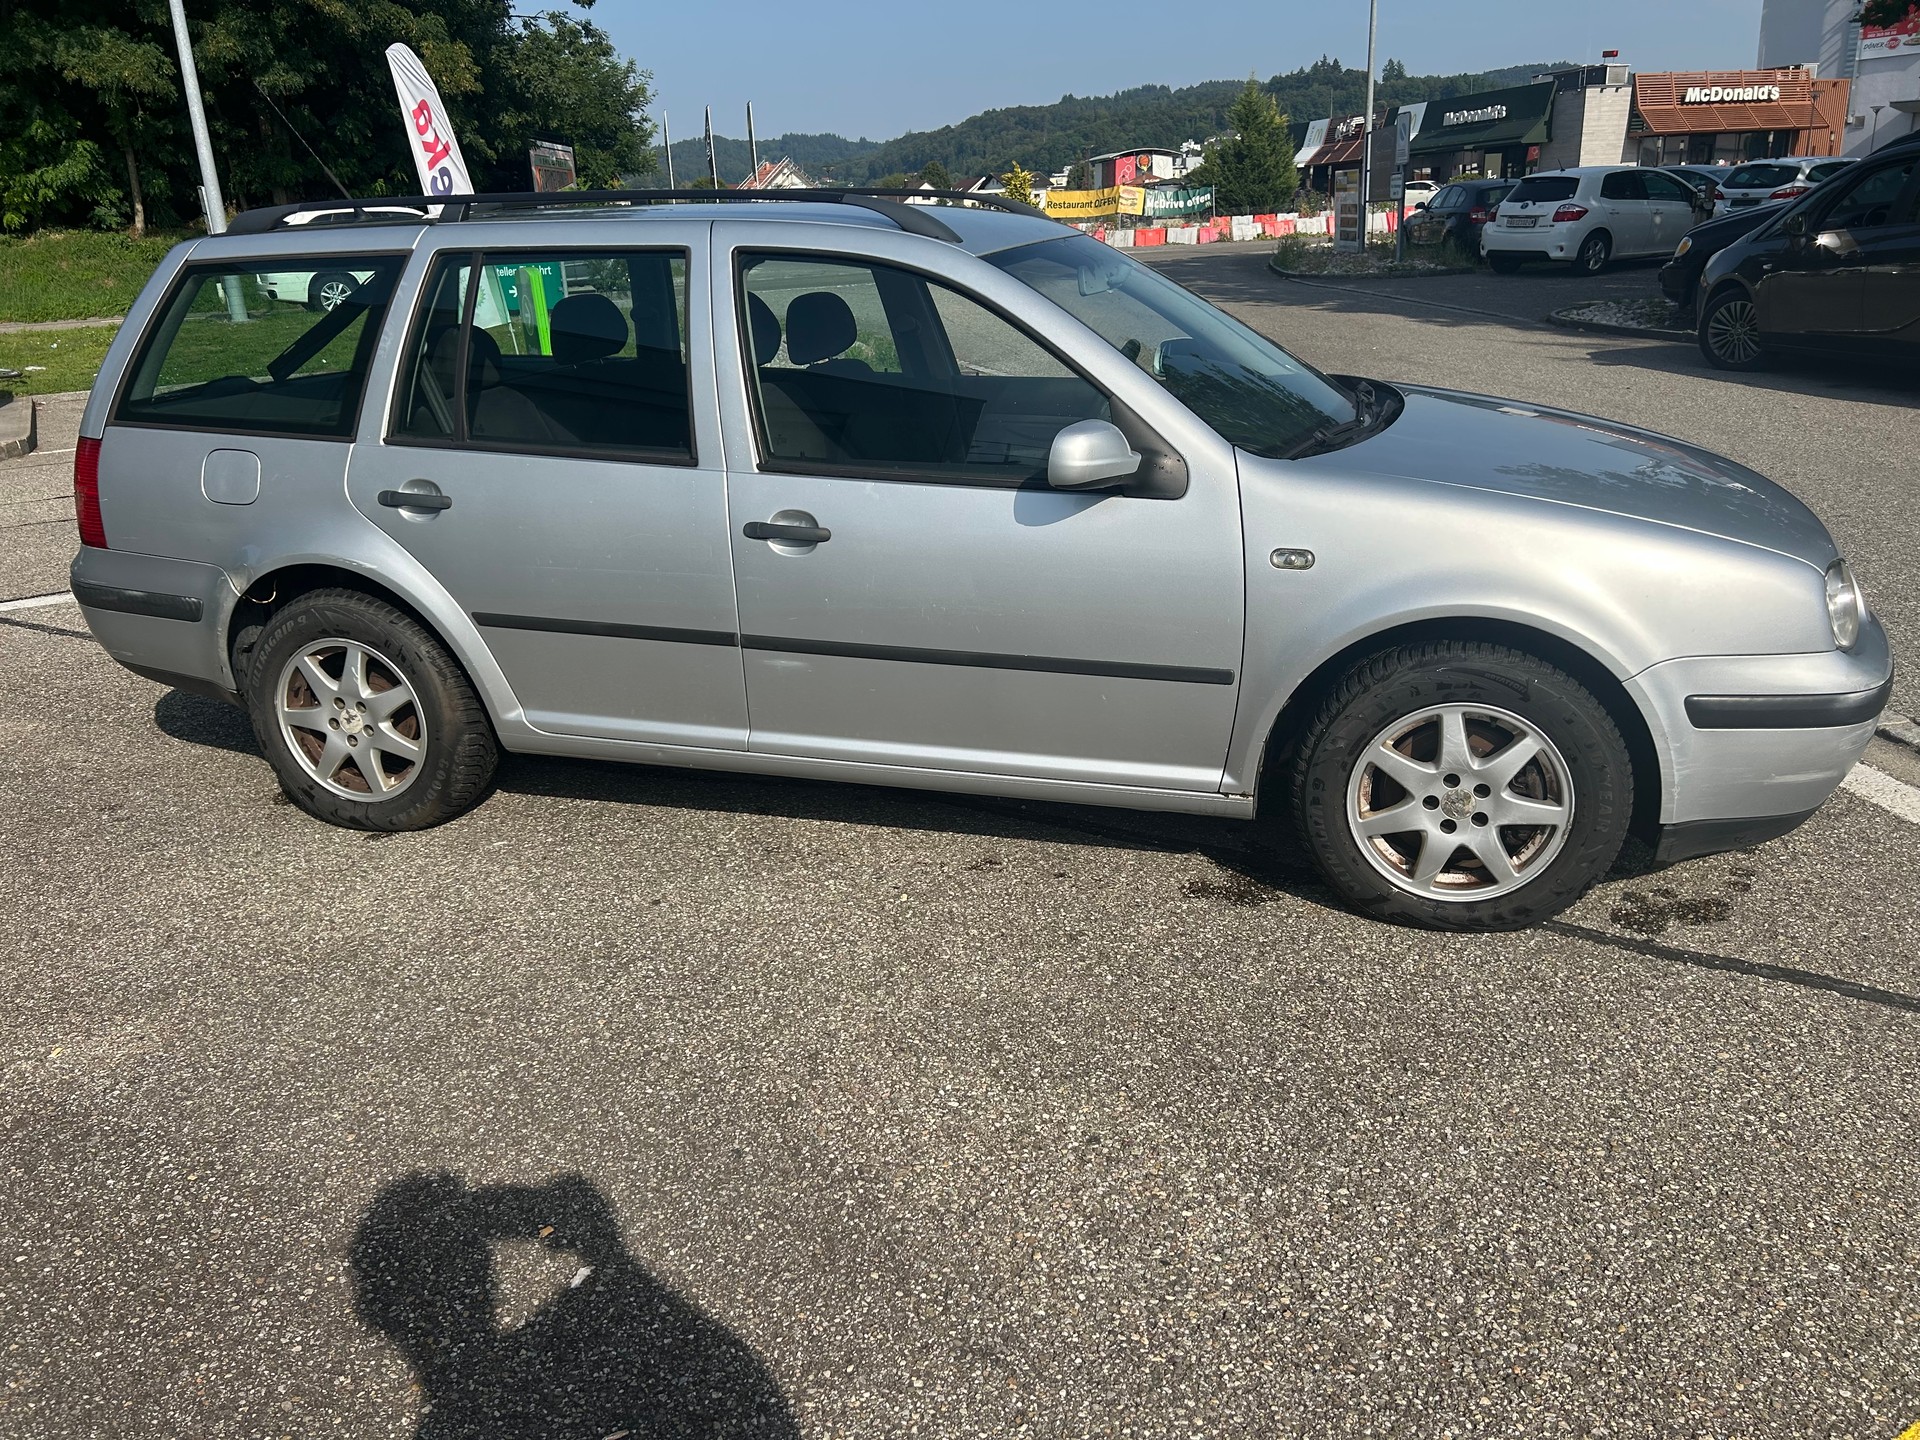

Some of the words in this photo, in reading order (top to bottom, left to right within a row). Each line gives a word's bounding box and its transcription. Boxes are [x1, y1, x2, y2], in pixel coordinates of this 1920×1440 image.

[1685, 85, 1780, 103] McDonald's
[1046, 200, 1093, 209] Restaurant
[1094, 196, 1117, 208] OFFEN
[1146, 197, 1184, 209] McDrive
[1187, 193, 1211, 207] offen
